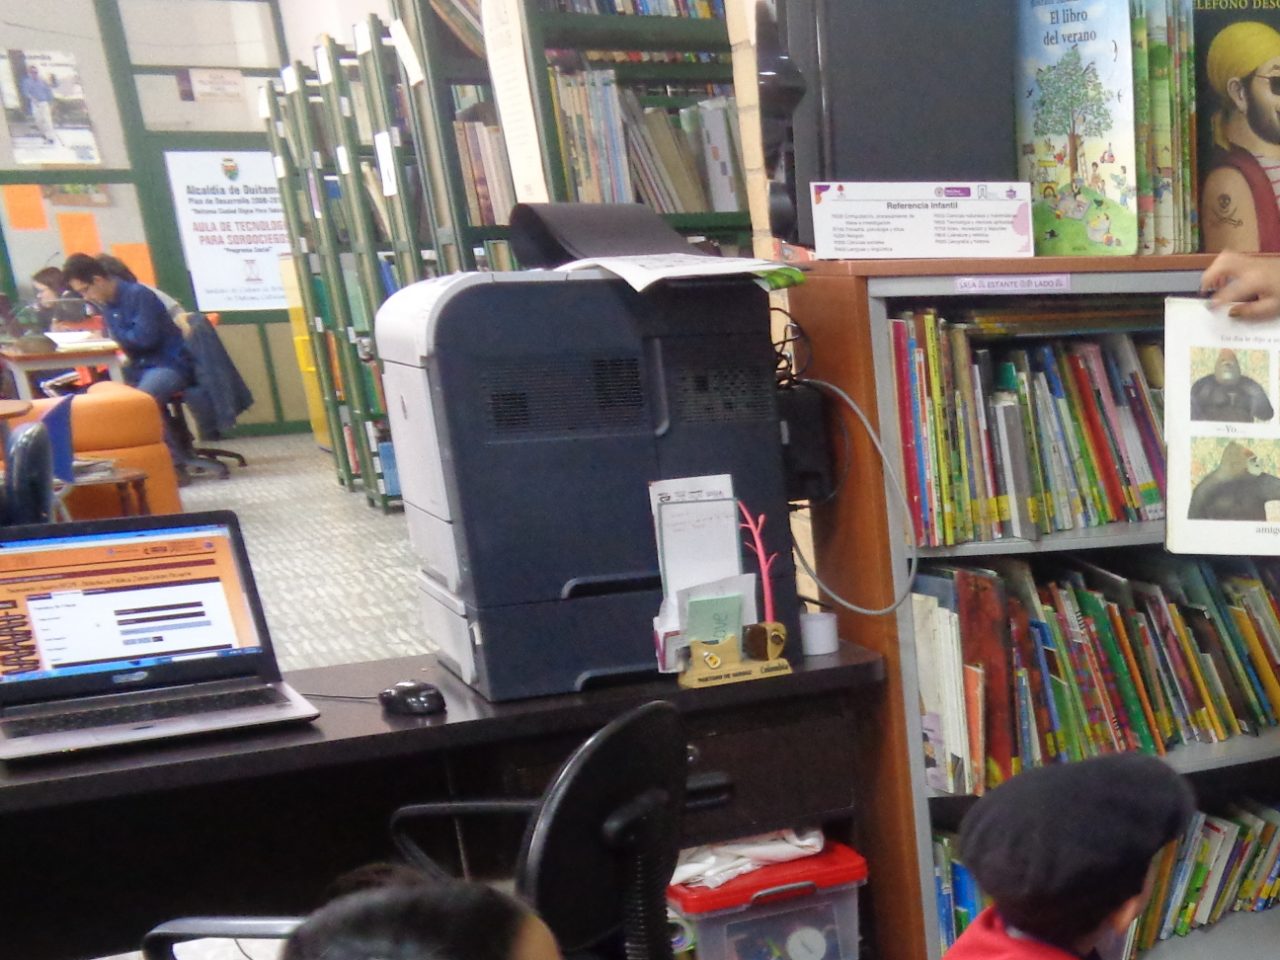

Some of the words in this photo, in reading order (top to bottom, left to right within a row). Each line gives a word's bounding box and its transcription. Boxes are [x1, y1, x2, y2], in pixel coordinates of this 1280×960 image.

[1195, 0, 1248, 10] LEFONO
[1050, 10, 1059, 25] El
[1063, 9, 1088, 24] libro
[1043, 30, 1059, 46] del
[1061, 30, 1097, 43] verano
[228, 185, 240, 195] de
[887, 201, 929, 209] Referencia
[221, 221, 232, 232] DE
[199, 235, 225, 245] PARA
[987, 280, 1018, 289] ESTANTE
[1034, 280, 1053, 288] LADO
